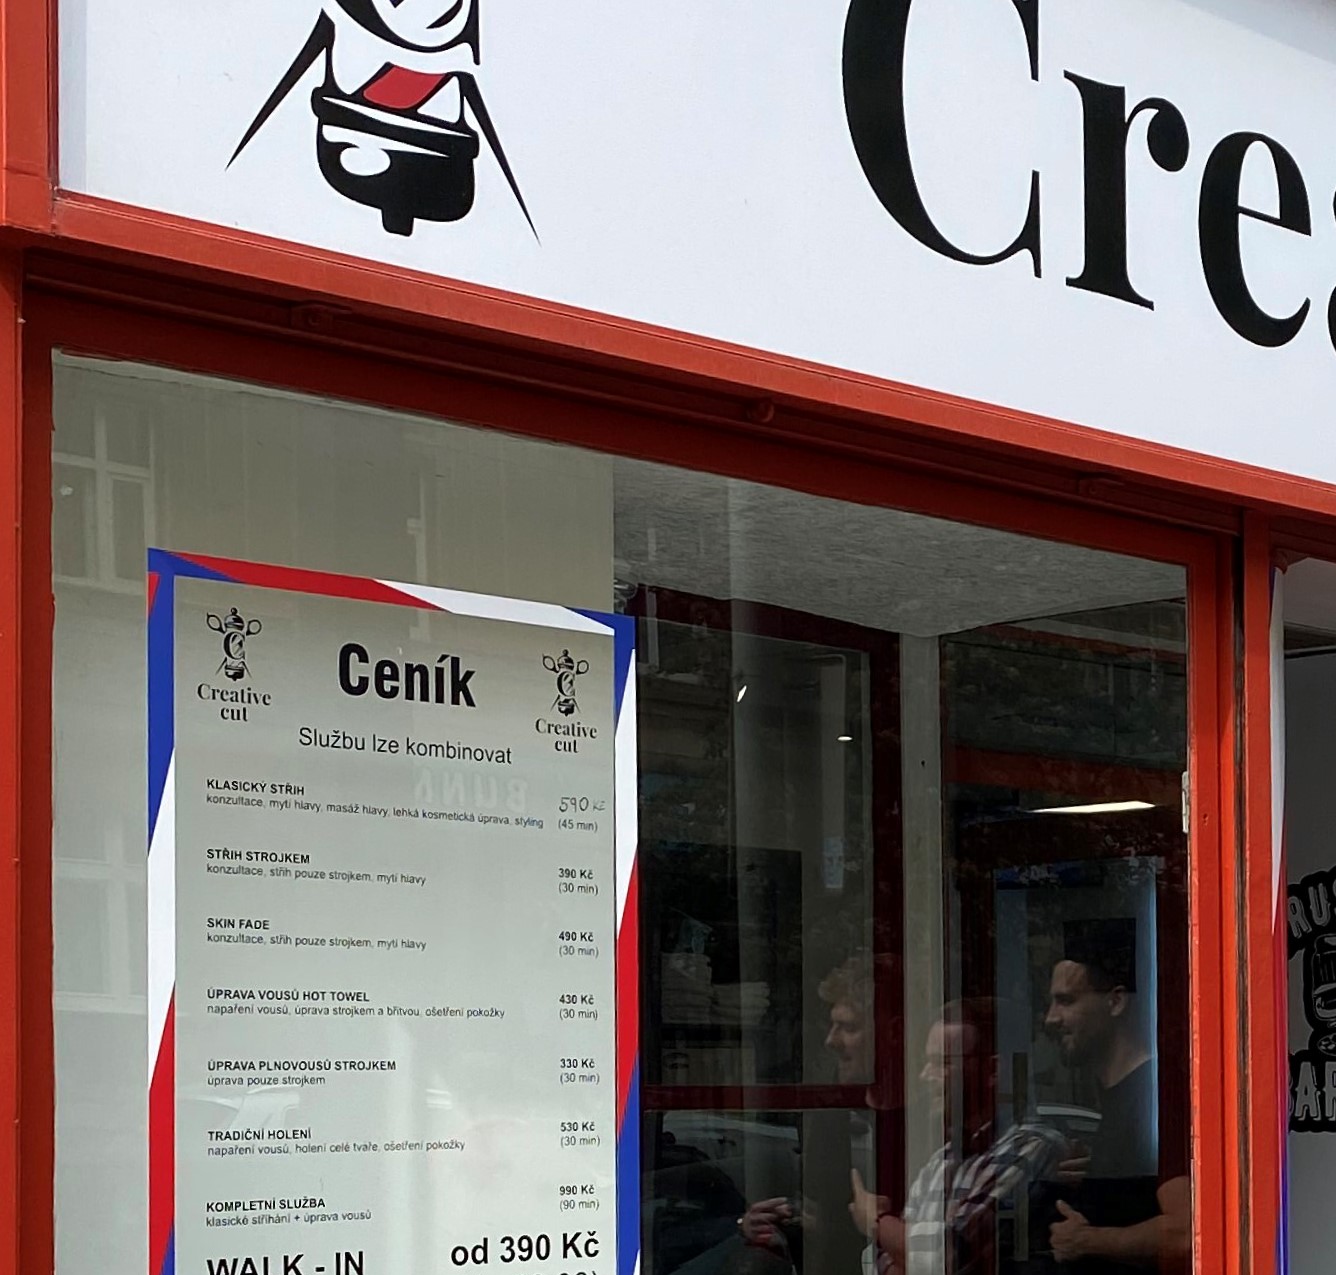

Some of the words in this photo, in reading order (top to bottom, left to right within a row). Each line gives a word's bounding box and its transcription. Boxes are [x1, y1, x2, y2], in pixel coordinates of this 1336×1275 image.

[338, 642, 477, 708] Ceník
[197, 682, 271, 707] Creative
[220, 704, 248, 723] cut
[535, 717, 597, 740] Creative
[299, 727, 366, 752] Službu
[372, 734, 399, 755] lze
[406, 737, 512, 765] kombinovat
[554, 737, 579, 754] cut
[207, 779, 267, 793] KLASICKÝ
[270, 783, 305, 796] STŘIH
[206, 794, 266, 808] konzultace,
[326, 801, 359, 814] masáž
[393, 807, 419, 818] lehká
[422, 808, 475, 822] kosmetická
[515, 816, 544, 829] styling
[558, 796, 590, 813] 590
[558, 820, 574, 832] (45
[576, 821, 598, 832] min)
[206, 847, 242, 861] STŘIH
[246, 851, 310, 864] STROJKEM
[206, 863, 266, 877] konzultace,
[270, 866, 292, 877] střih
[294, 869, 326, 880] pouze
[400, 874, 426, 887] hlavy
[558, 867, 576, 879] 390
[579, 867, 594, 880] Kč
[558, 882, 575, 896] (30
[577, 882, 599, 896] min)
[206, 917, 236, 930] SKIN
[239, 919, 270, 930] FADE
[206, 932, 266, 945] konzultace,
[270, 934, 292, 945] střih
[295, 936, 326, 948] pouze
[401, 939, 427, 952] hlavy
[558, 931, 576, 943] 490
[579, 930, 594, 943] Kč
[558, 944, 575, 958] (30
[577, 945, 599, 958] min)
[207, 987, 256, 1000] ÚPRAVA
[258, 988, 299, 1001] VOUSŮ
[303, 991, 327, 1002] HOT
[331, 991, 370, 1002] TOWEL
[559, 994, 577, 1005] 430
[580, 994, 595, 1005] Kč
[207, 1003, 254, 1016] napaření
[258, 1004, 292, 1016] vousů,
[295, 1005, 330, 1017] úprava
[332, 1006, 375, 1018] strojkem
[425, 1006, 464, 1017] ošetření
[467, 1007, 505, 1019] pokožky
[559, 1008, 575, 1020] (30
[578, 1008, 599, 1021] min)
[207, 1059, 256, 1071] ÚPRAVA
[259, 1059, 332, 1071] PLNOVOUSŮ
[334, 1061, 396, 1071] STROJKEM
[560, 1058, 578, 1069] 330
[582, 1057, 596, 1069] Kč
[207, 1075, 244, 1087] úprava
[247, 1077, 279, 1087] pouze
[282, 1075, 326, 1087] strojkem
[560, 1072, 576, 1085] (30
[579, 1072, 600, 1085] min)
[560, 1121, 577, 1132] 530
[581, 1120, 595, 1132] Kč
[208, 1128, 265, 1141] TRADIČNÍ
[268, 1127, 312, 1140] HOLENÍ
[560, 1134, 576, 1148] (30
[579, 1134, 601, 1148] min)
[207, 1144, 254, 1157] napaření
[295, 1141, 326, 1153] holení
[329, 1141, 350, 1153] celé
[383, 1140, 423, 1152] ošetření
[426, 1139, 466, 1153] pokožky
[559, 1184, 577, 1196] 990
[580, 1183, 594, 1196] Kč
[206, 1196, 276, 1213] KOMPLETNÍ
[279, 1196, 326, 1210] SLUŽBA
[559, 1198, 576, 1211] (90
[578, 1197, 600, 1211] min)
[206, 1214, 249, 1227] klasické
[252, 1212, 291, 1225] stříhání
[303, 1211, 338, 1224] úprava
[341, 1209, 372, 1221] vousů
[451, 1237, 488, 1266] od
[500, 1234, 551, 1263] 390
[562, 1231, 600, 1259] Kč
